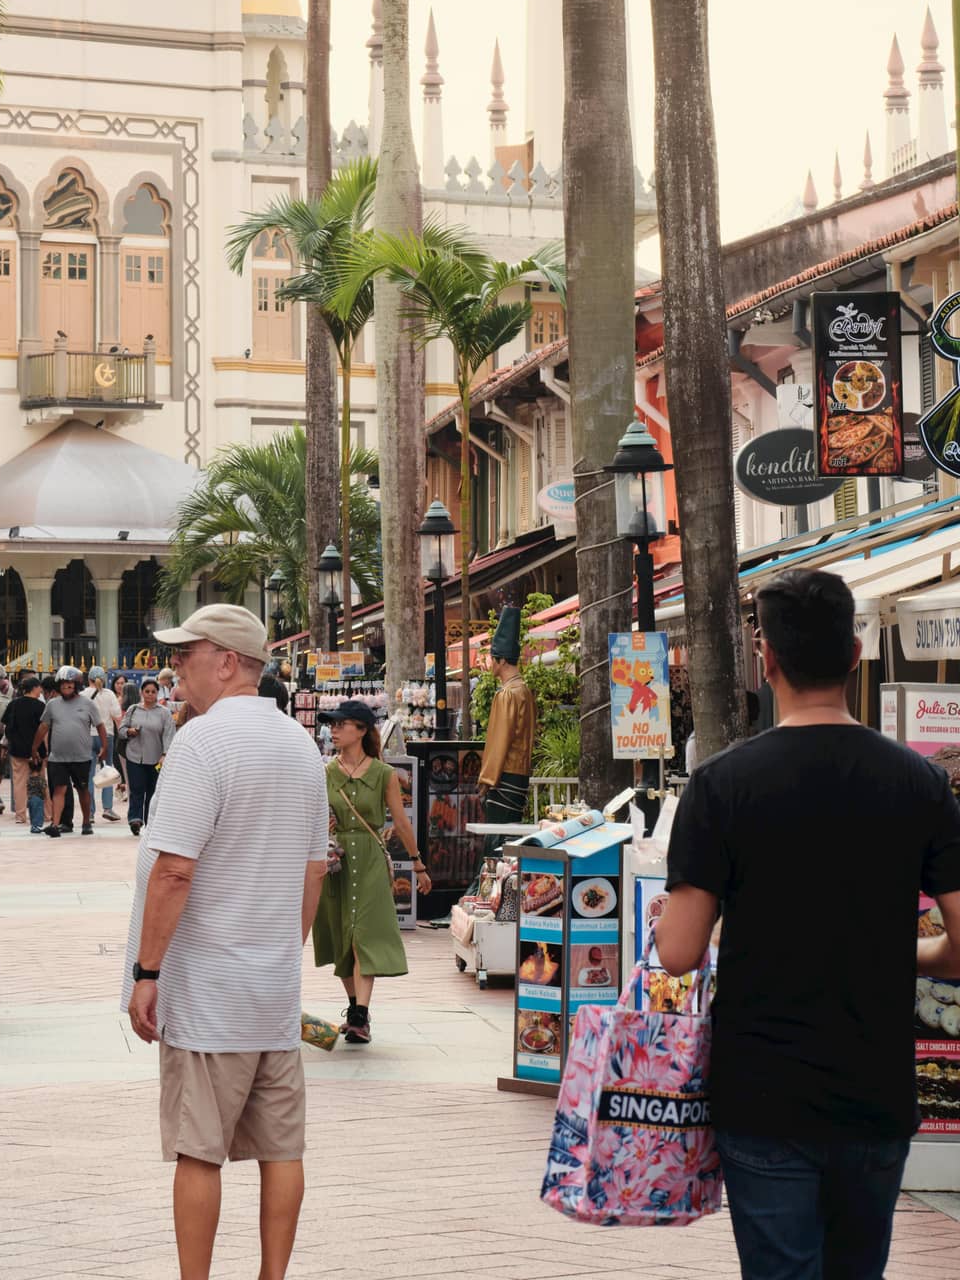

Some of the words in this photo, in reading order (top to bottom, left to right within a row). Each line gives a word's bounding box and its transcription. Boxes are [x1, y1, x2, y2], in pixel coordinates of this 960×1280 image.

[746, 446, 816, 477] kondit
[916, 699, 946, 719] Julie
[632, 722, 649, 735] NO
